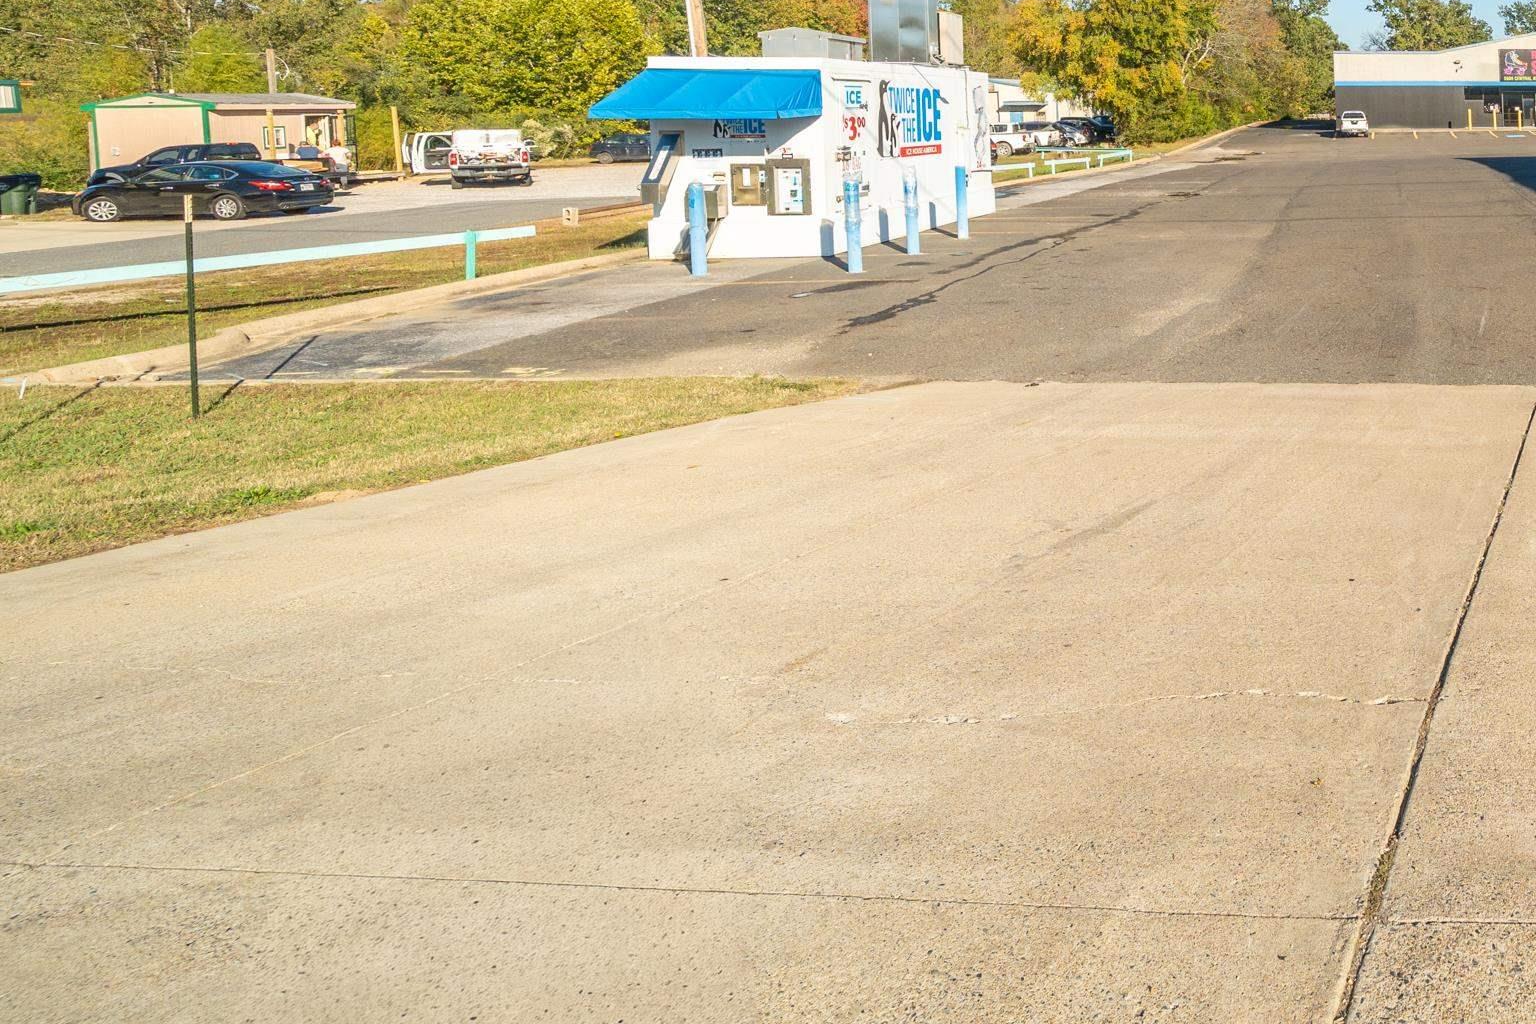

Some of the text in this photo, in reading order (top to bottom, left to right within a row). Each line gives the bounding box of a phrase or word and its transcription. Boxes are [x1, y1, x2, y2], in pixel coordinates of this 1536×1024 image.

[846, 90, 862, 105] ICE
[888, 87, 915, 114] TWICE
[732, 118, 766, 134] THE ICE
[901, 88, 942, 143] THE ICE
